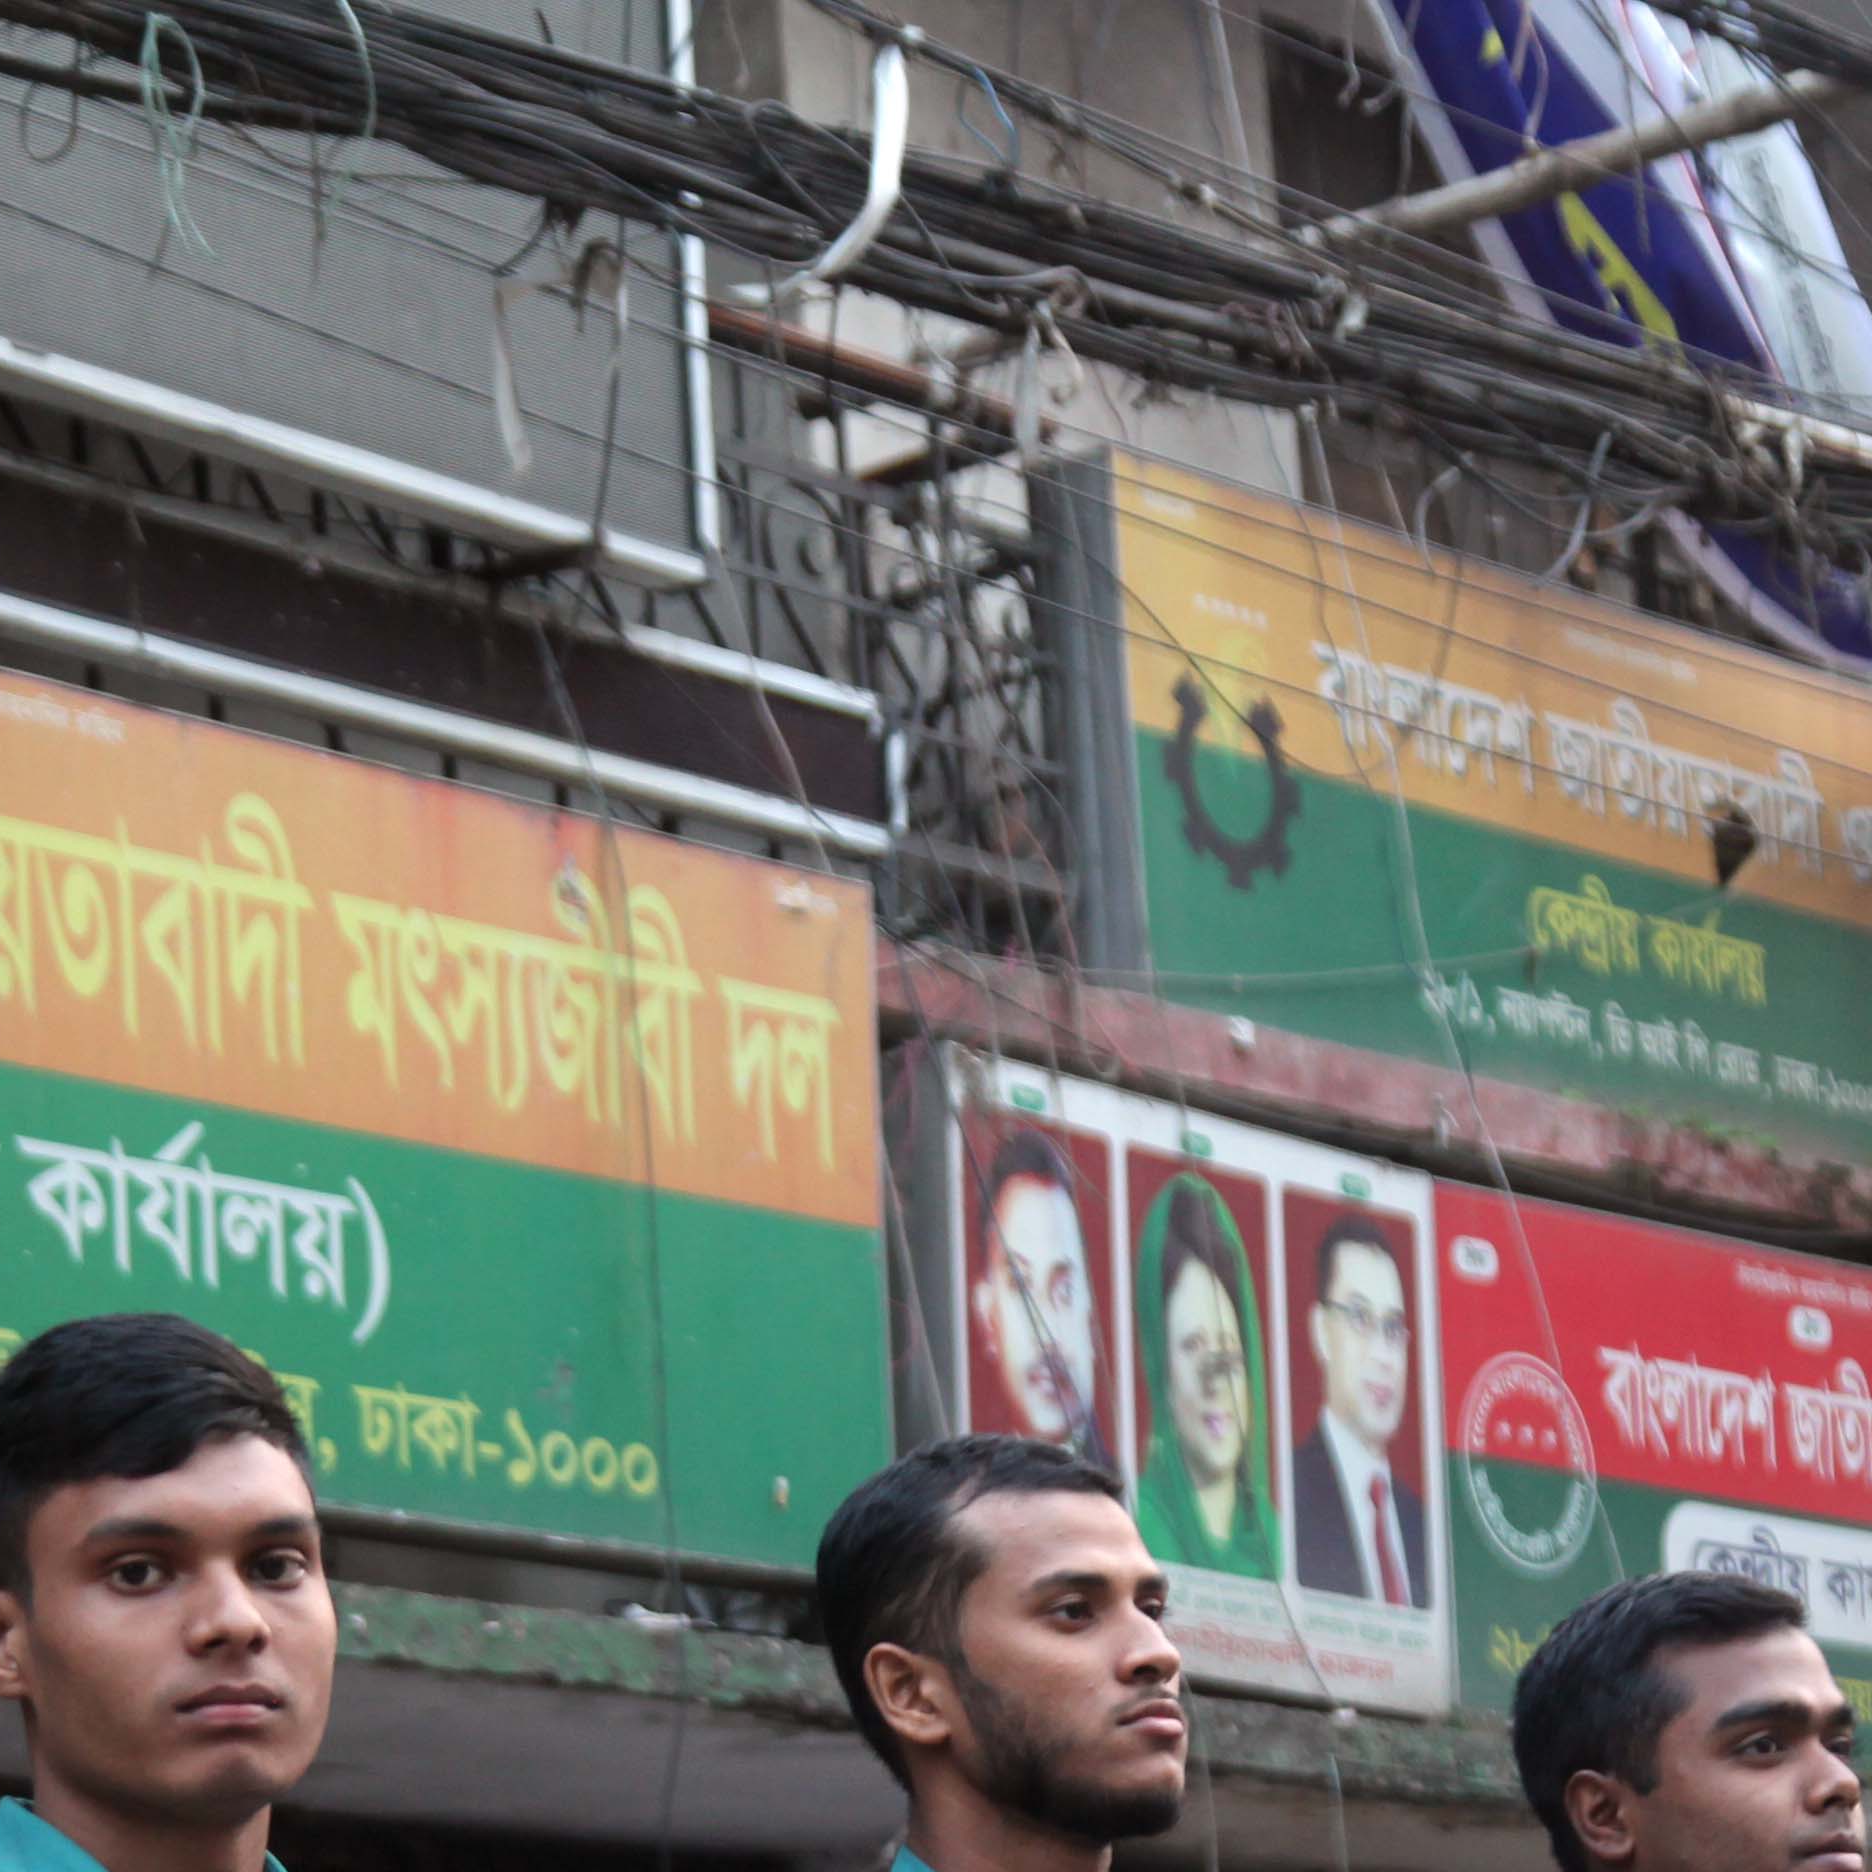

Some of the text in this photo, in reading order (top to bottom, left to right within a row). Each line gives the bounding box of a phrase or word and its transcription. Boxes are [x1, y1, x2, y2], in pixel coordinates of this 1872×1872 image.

[333, 866, 702, 1145] মৎস্যজীবী
[718, 975, 840, 1172] দল
[14, 1120, 393, 1346] কার্যালয়)
[352, 1381, 659, 1496] ঢাকা-১০০০
[1598, 1341, 1777, 1470] বাংলাদেশ
